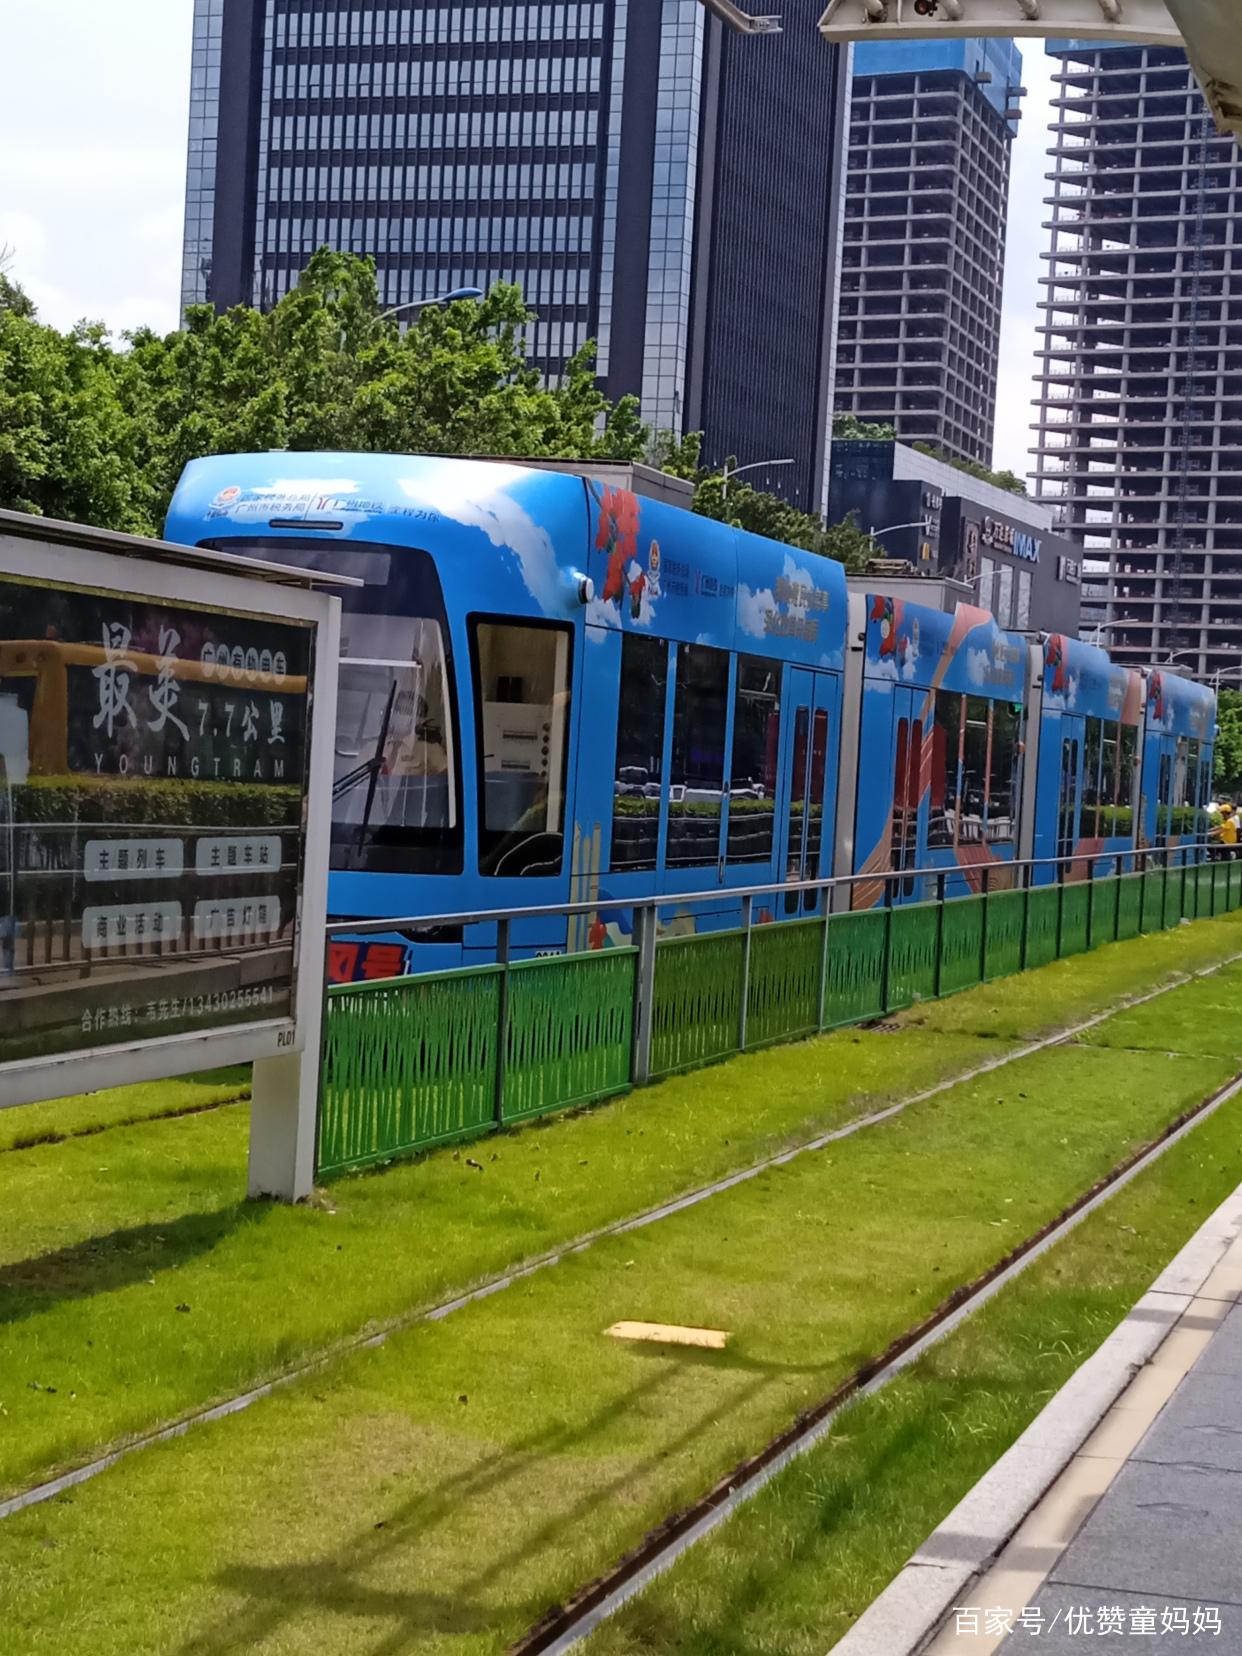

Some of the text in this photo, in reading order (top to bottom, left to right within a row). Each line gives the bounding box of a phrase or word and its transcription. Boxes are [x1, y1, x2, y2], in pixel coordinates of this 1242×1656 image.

[235, 502, 306, 514] 广州市税务局
[1012, 531, 1042, 564] IMAX
[201, 643, 286, 685] 广州有轨电车
[92, 621, 190, 741] 最美
[197, 698, 286, 745] 7.7公里
[98, 847, 166, 870] 主题列车
[210, 845, 270, 867] 主题车站
[96, 911, 164, 939] 商业活动
[209, 904, 268, 929] 广告灯箱
